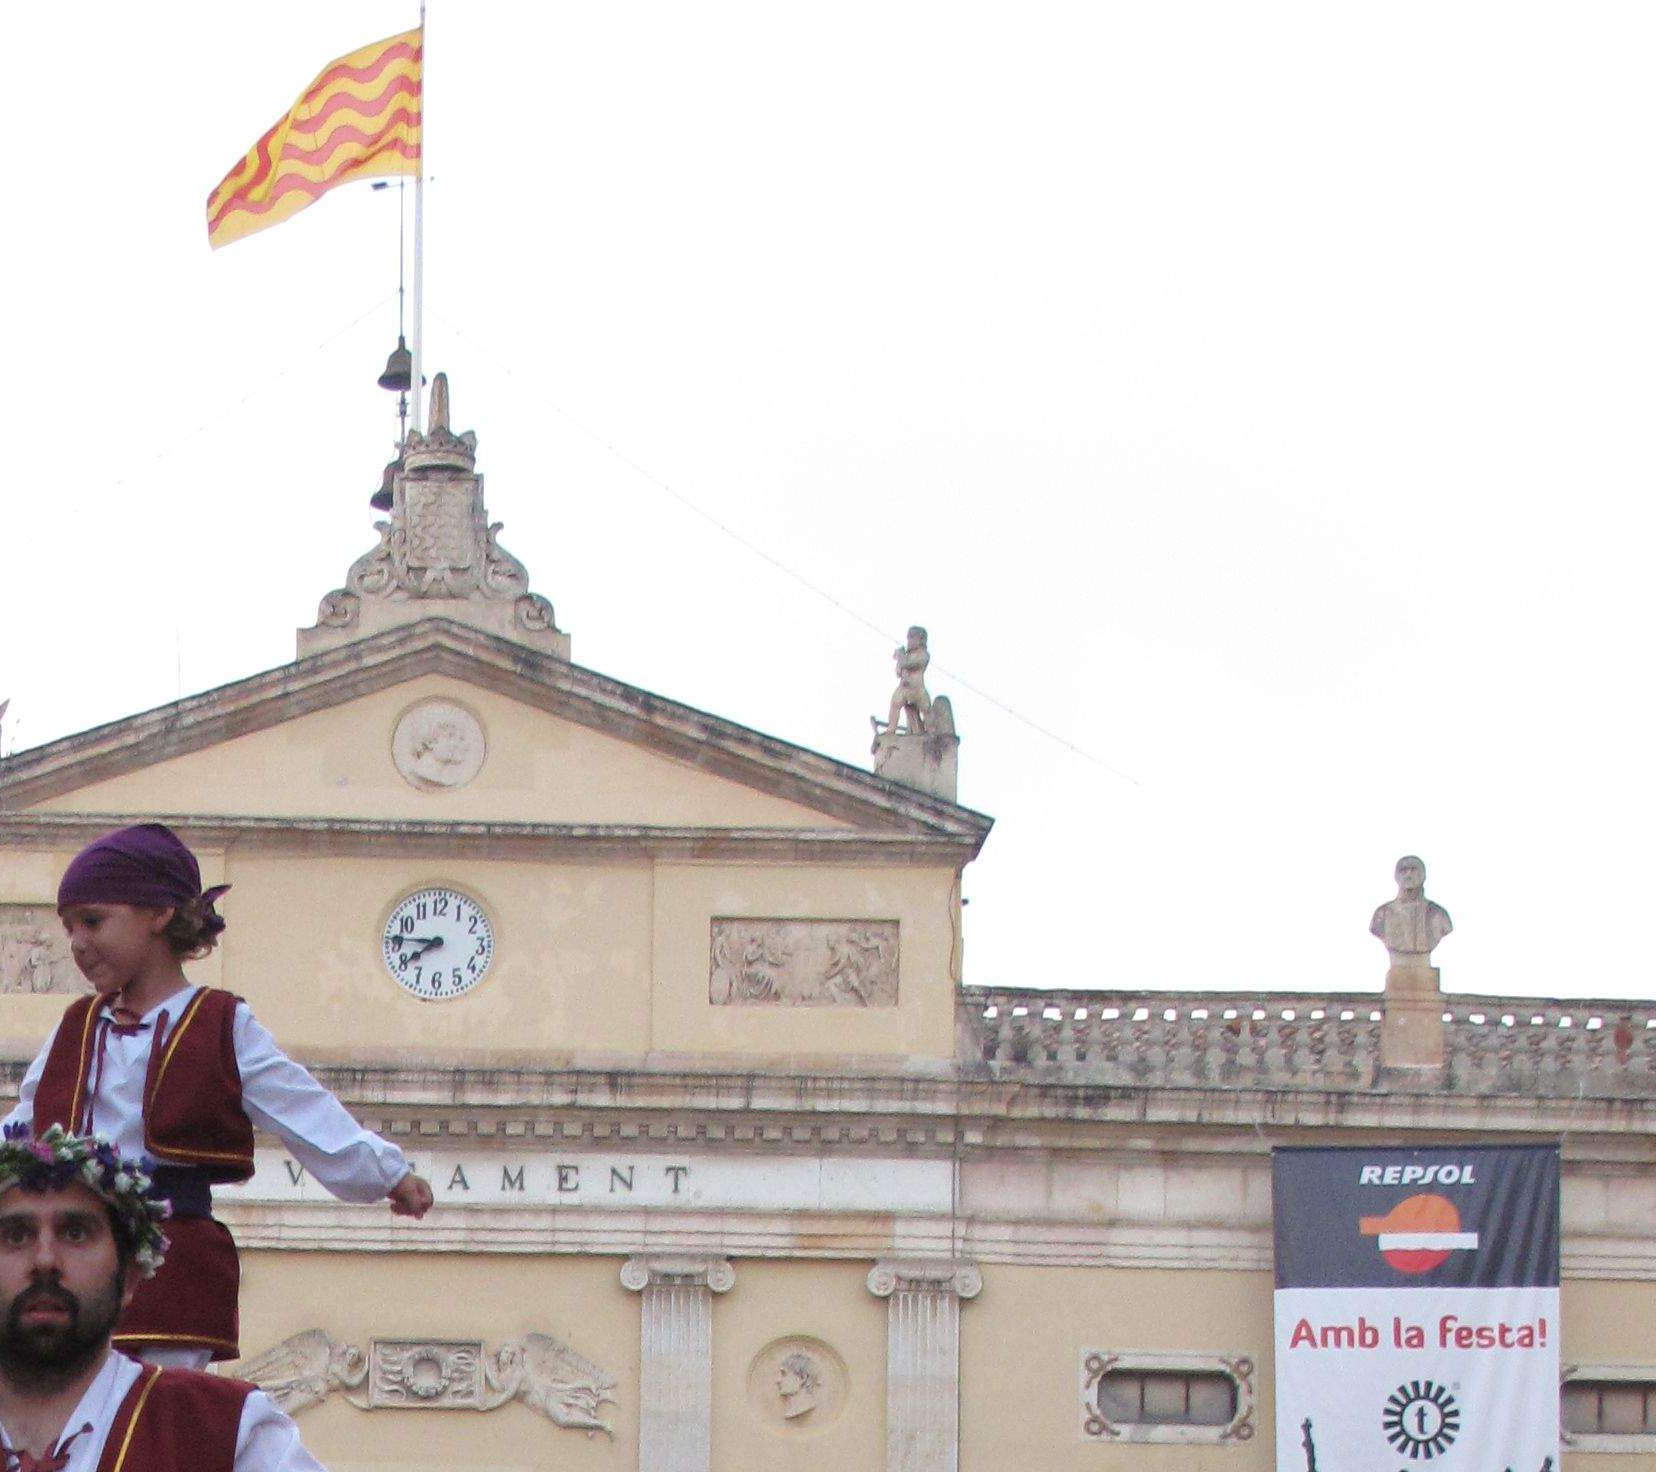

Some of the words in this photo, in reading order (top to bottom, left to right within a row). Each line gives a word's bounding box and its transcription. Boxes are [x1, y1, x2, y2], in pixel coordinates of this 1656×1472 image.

[416, 902, 427, 920] 11
[433, 898, 449, 917] 12
[455, 903, 461, 922] 1
[399, 917, 415, 934] 10
[468, 916, 478, 934] 2
[476, 937, 486, 955] 3
[467, 956, 476, 974] 4
[414, 966, 423, 985] 7
[431, 971, 442, 990] 6
[452, 968, 462, 986] 5
[1358, 1164, 1477, 1185] REPSOL
[1289, 1316, 1380, 1350] Amb
[1393, 1316, 1425, 1349] la
[1439, 1314, 1548, 1350] festa!
